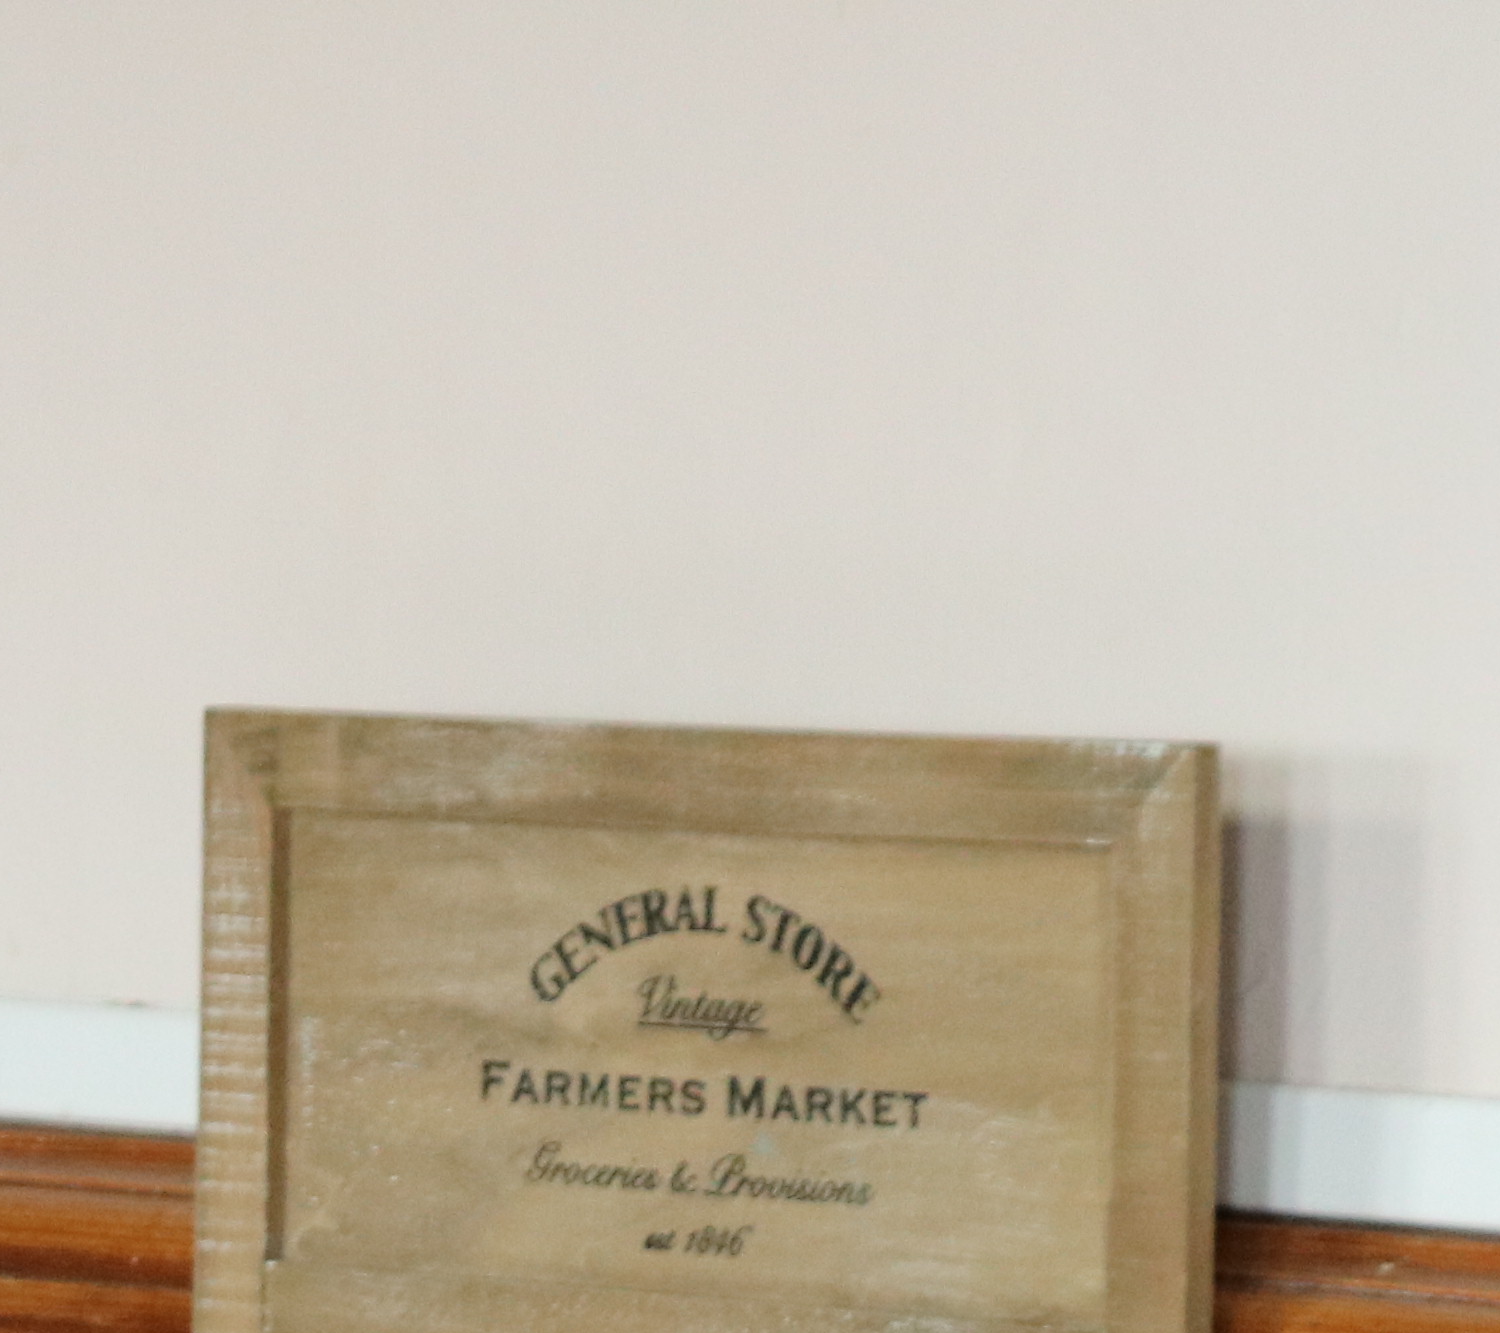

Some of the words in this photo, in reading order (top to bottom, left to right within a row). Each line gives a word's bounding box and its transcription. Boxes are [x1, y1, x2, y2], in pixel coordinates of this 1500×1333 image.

[529, 885, 727, 1002] GENERAL
[740, 895, 882, 1026] STORE
[636, 974, 767, 1039] Vintage
[523, 1139, 660, 1193] Groceries
[703, 1152, 875, 1206] Provisions
